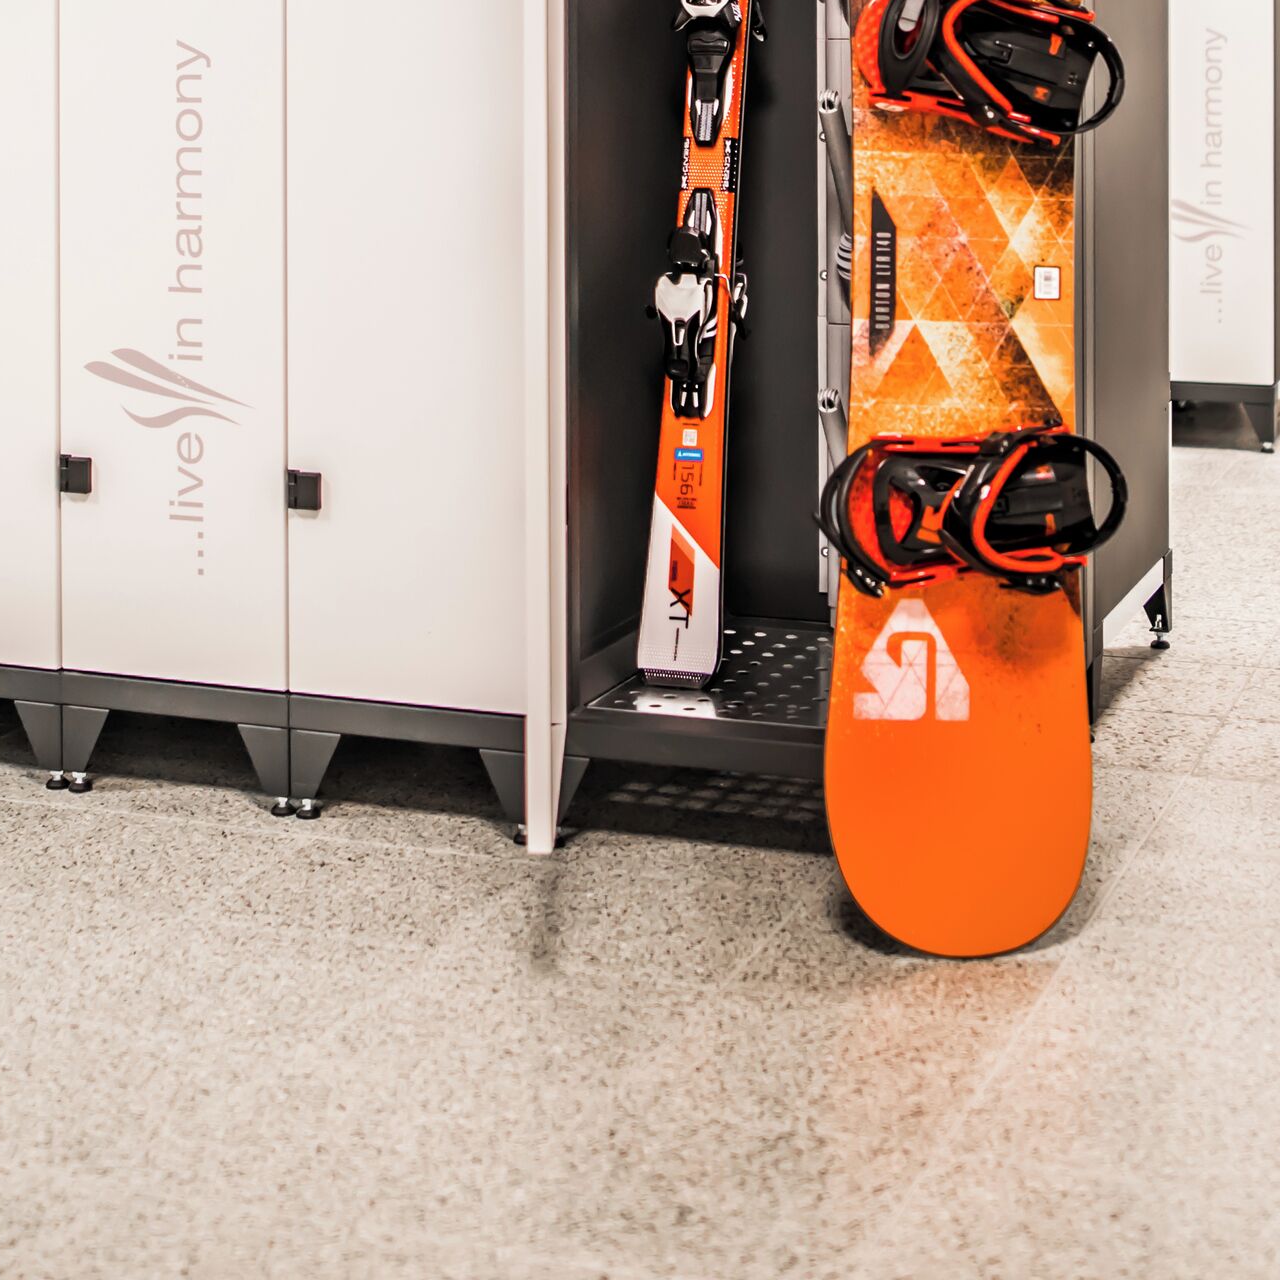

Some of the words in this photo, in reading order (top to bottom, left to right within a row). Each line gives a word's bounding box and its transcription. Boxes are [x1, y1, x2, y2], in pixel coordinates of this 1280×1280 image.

[1200, 28, 1228, 168] harmony
[168, 39, 212, 294] harmony
[1200, 180, 1223, 206] in
[876, 232, 892, 251] 140
[1200, 243, 1223, 324] ...live
[875, 283, 891, 330] BURTON
[168, 318, 204, 362] in
[679, 464, 694, 496] 156
[168, 431, 205, 576] ...live
[669, 587, 691, 629] XT
